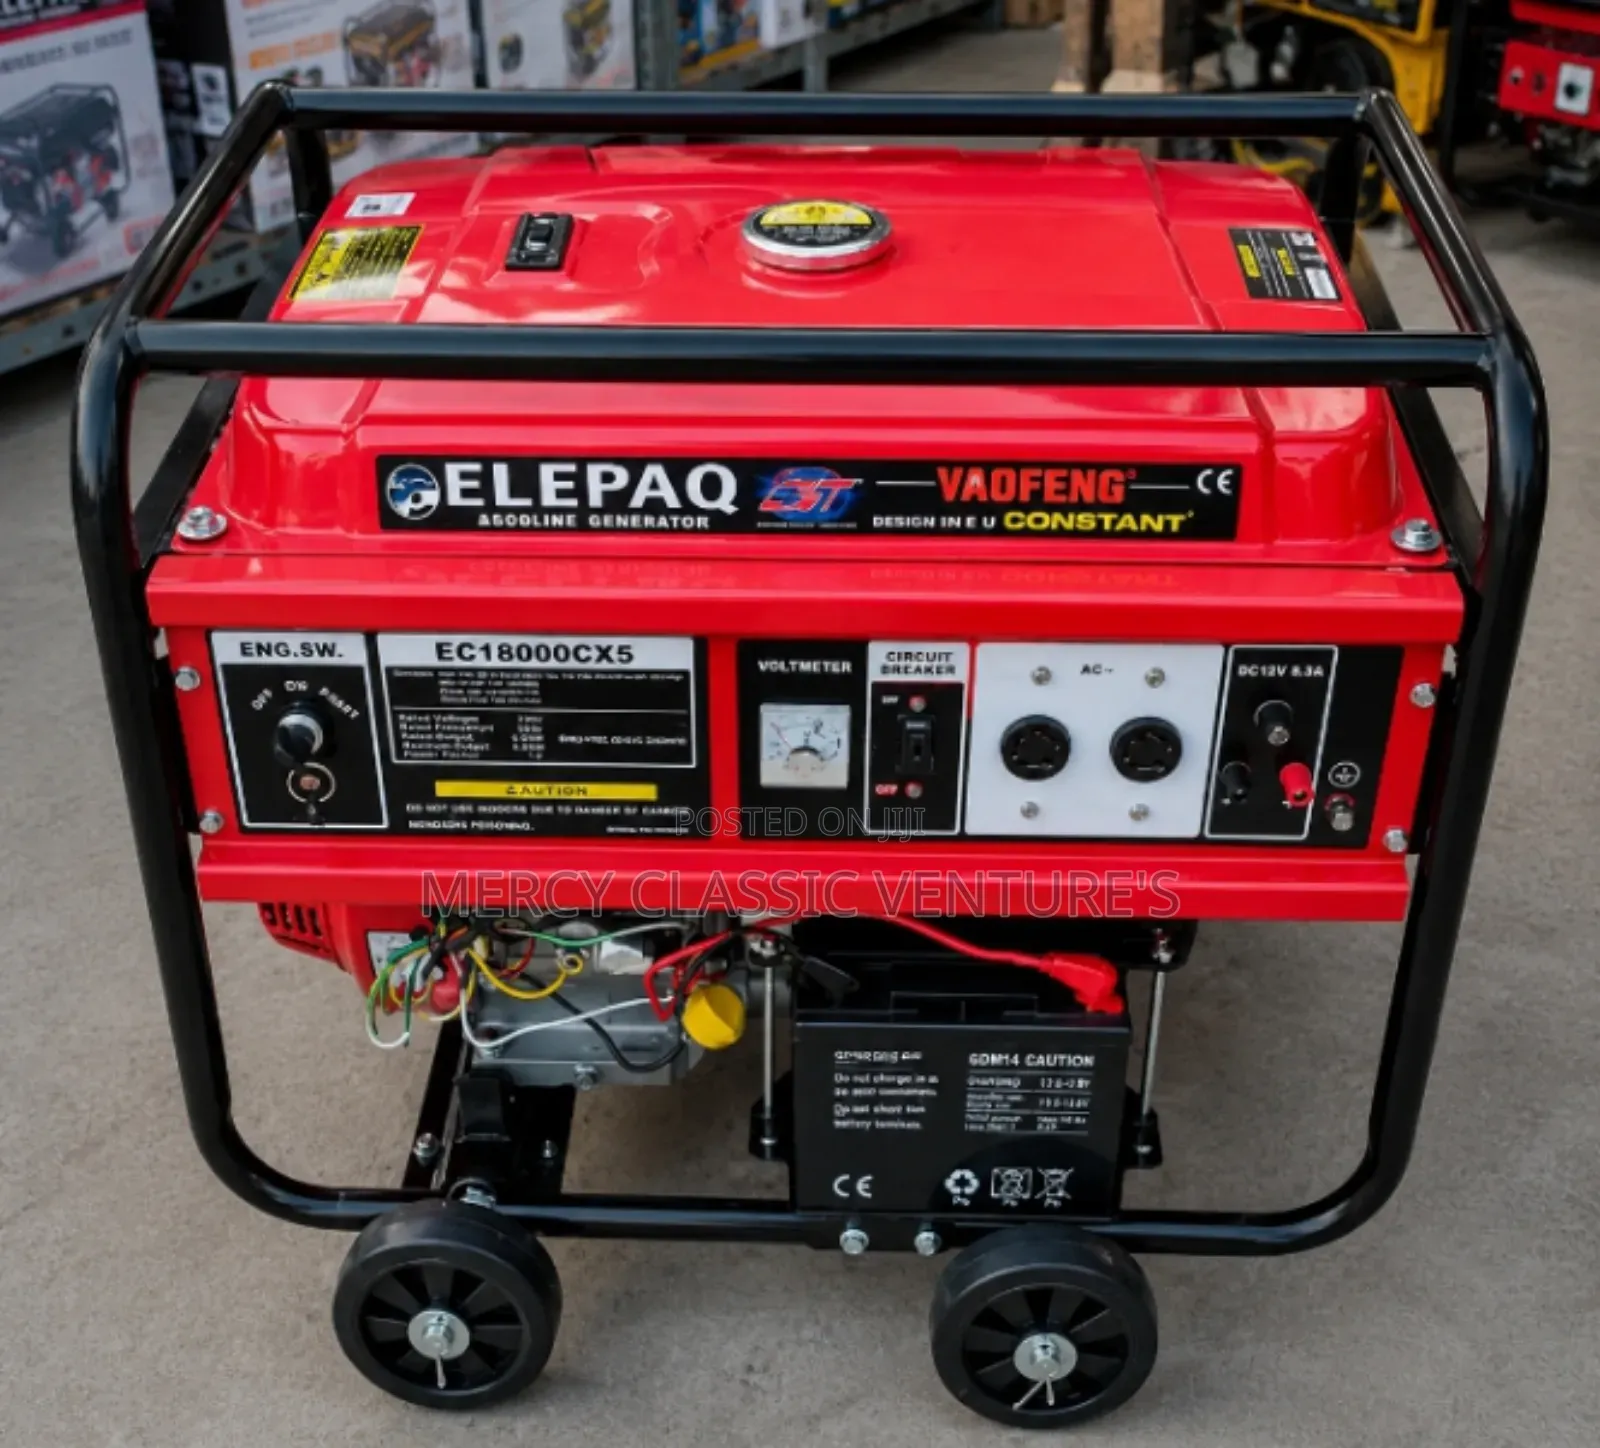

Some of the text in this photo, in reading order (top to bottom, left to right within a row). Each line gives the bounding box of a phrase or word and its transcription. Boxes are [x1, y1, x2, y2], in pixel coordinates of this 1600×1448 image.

[445, 462, 739, 515] ELEPAQ
[937, 467, 1126, 503] VAOFENG
[1197, 469, 1233, 494] CE
[588, 514, 709, 529] GENERATOR
[873, 515, 935, 528] DESIGN
[1004, 511, 1185, 531] CONSTANT
[240, 642, 343, 657] ENG.SW.
[435, 642, 634, 664] EC18000CX5
[885, 651, 954, 662] CIRCUIT
[757, 659, 852, 673] VOLTMETER
[880, 664, 956, 675] BREAKER
[1238, 664, 1288, 677] DC12V
[1024, 1053, 1095, 1068] CAUTION
[832, 1175, 874, 1198] CE
